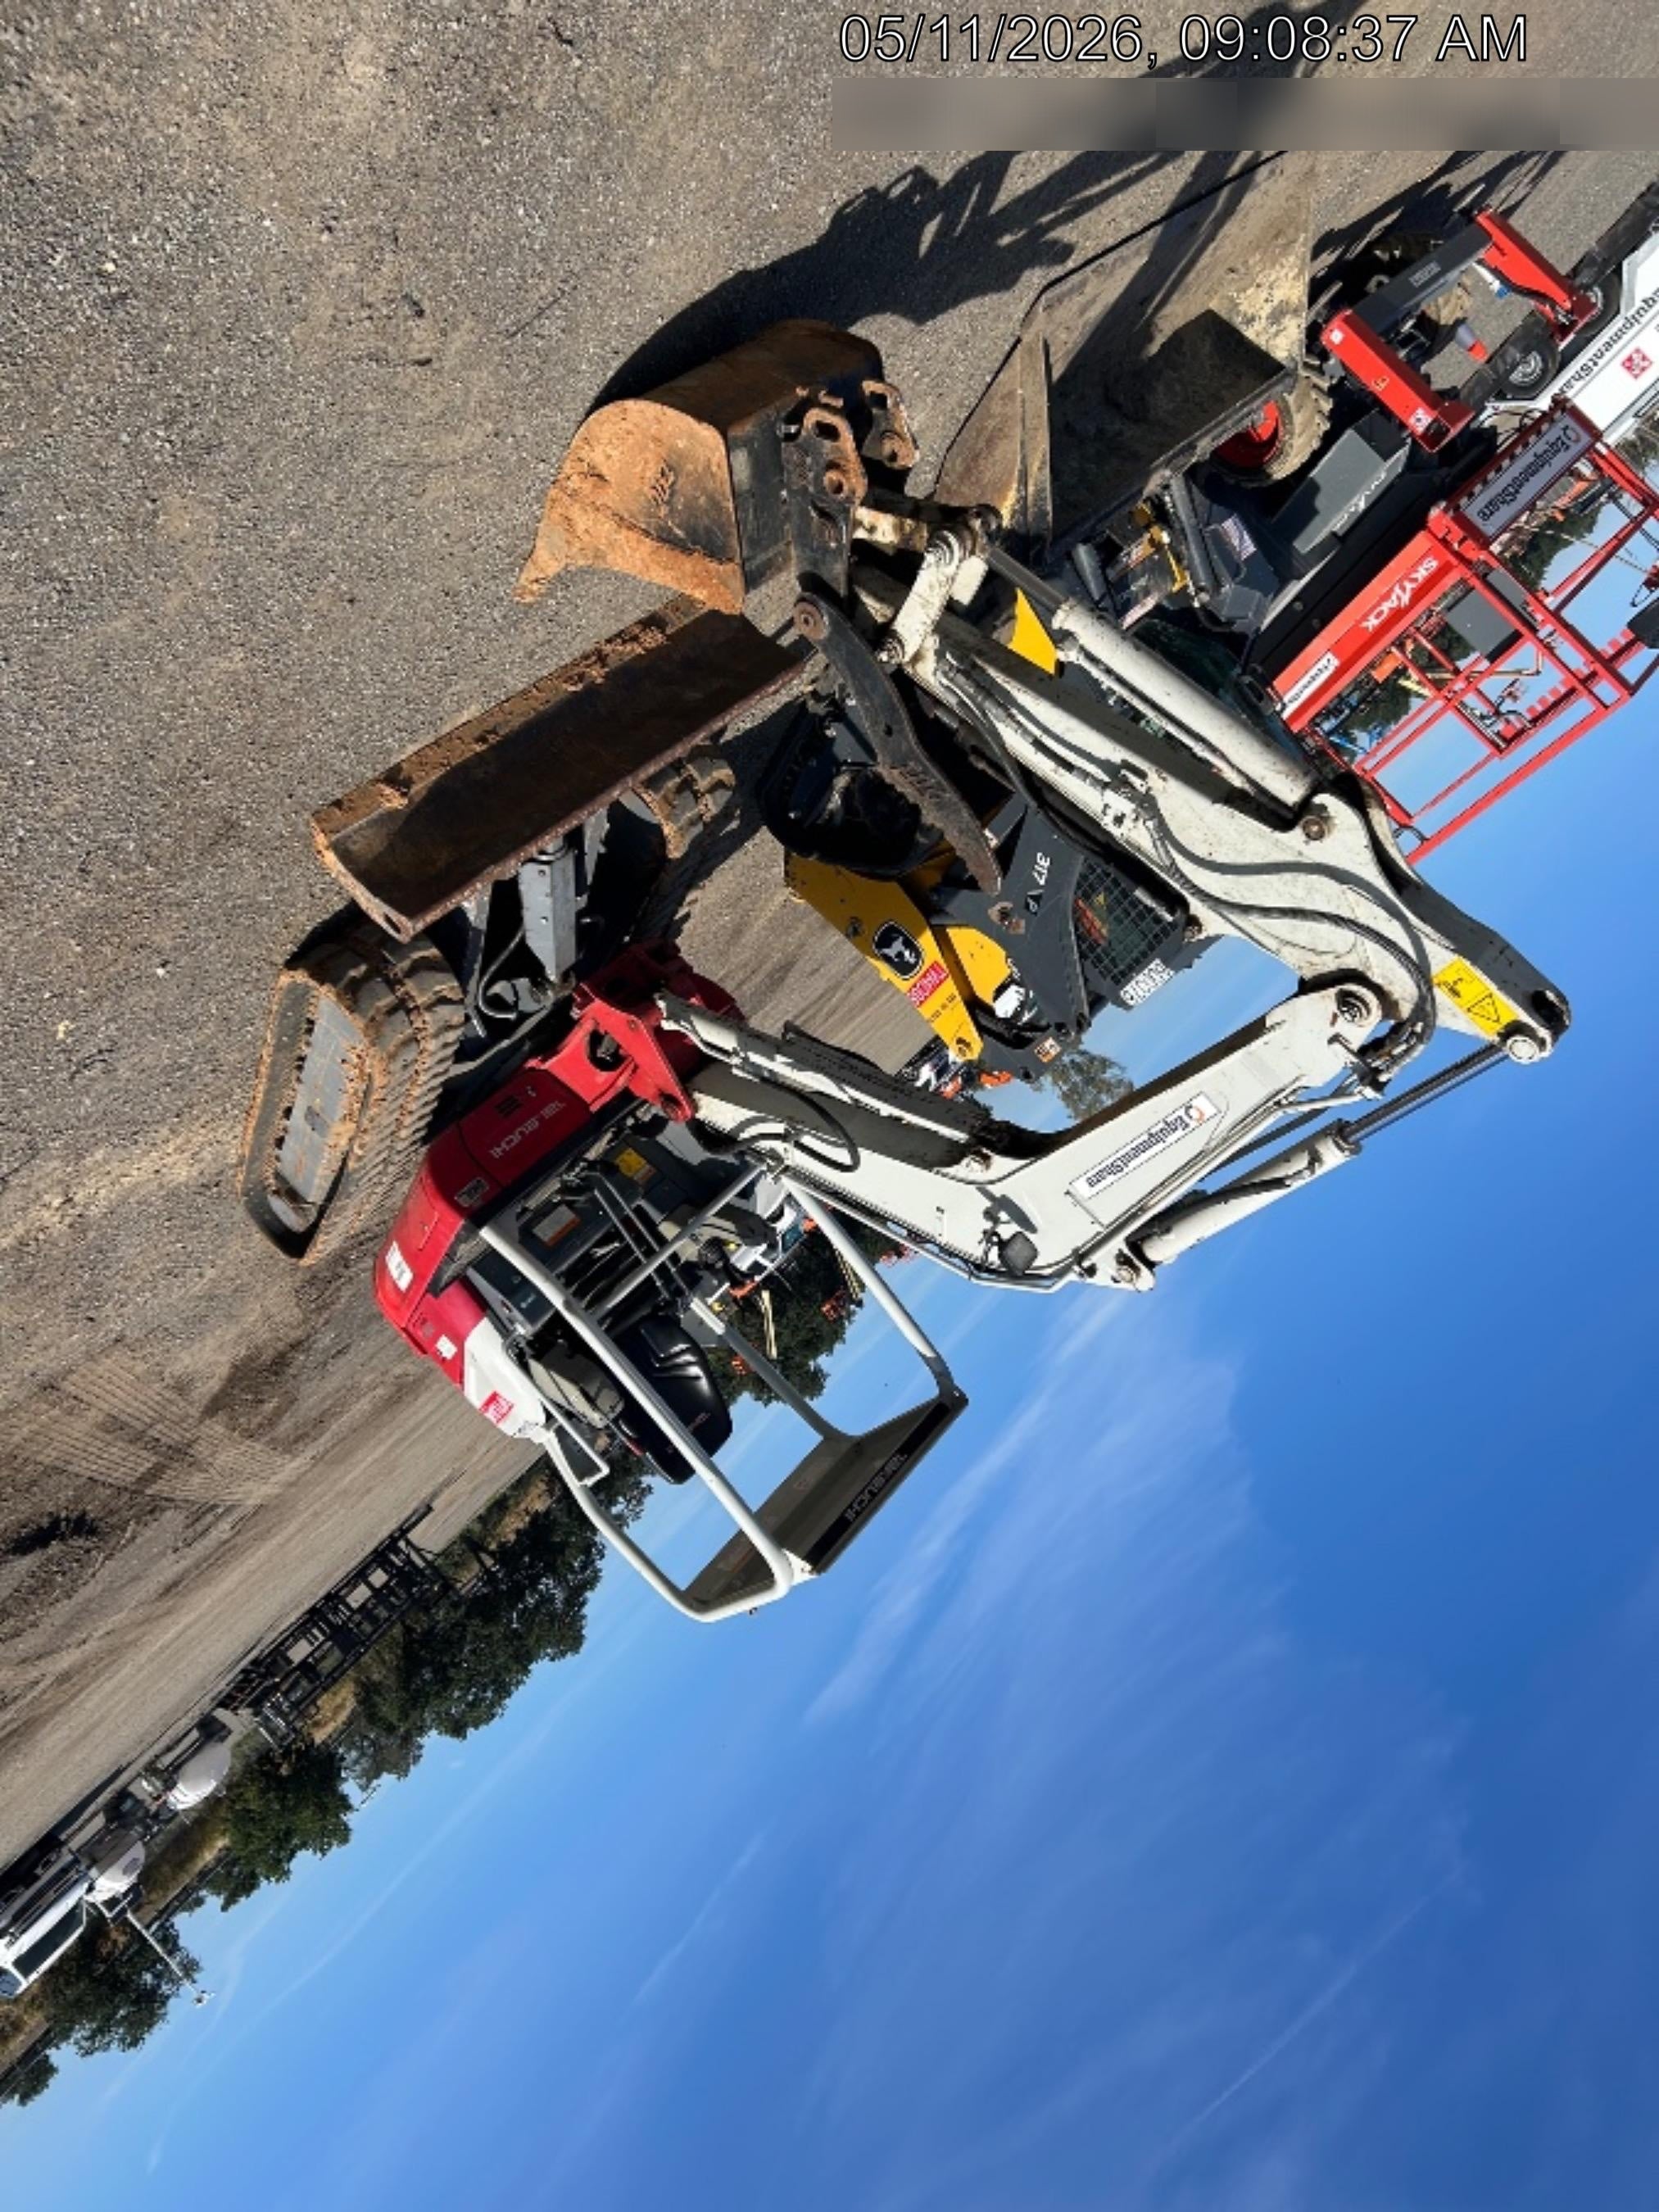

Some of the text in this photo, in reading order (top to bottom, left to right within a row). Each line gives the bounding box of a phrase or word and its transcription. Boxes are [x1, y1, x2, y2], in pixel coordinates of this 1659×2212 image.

[1477, 437, 1570, 522] EquipmentShare
[1360, 556, 1439, 632] SKYJACK
[1033, 852, 1050, 886] 317
[1086, 1114, 1190, 1187] EquipmentShare
